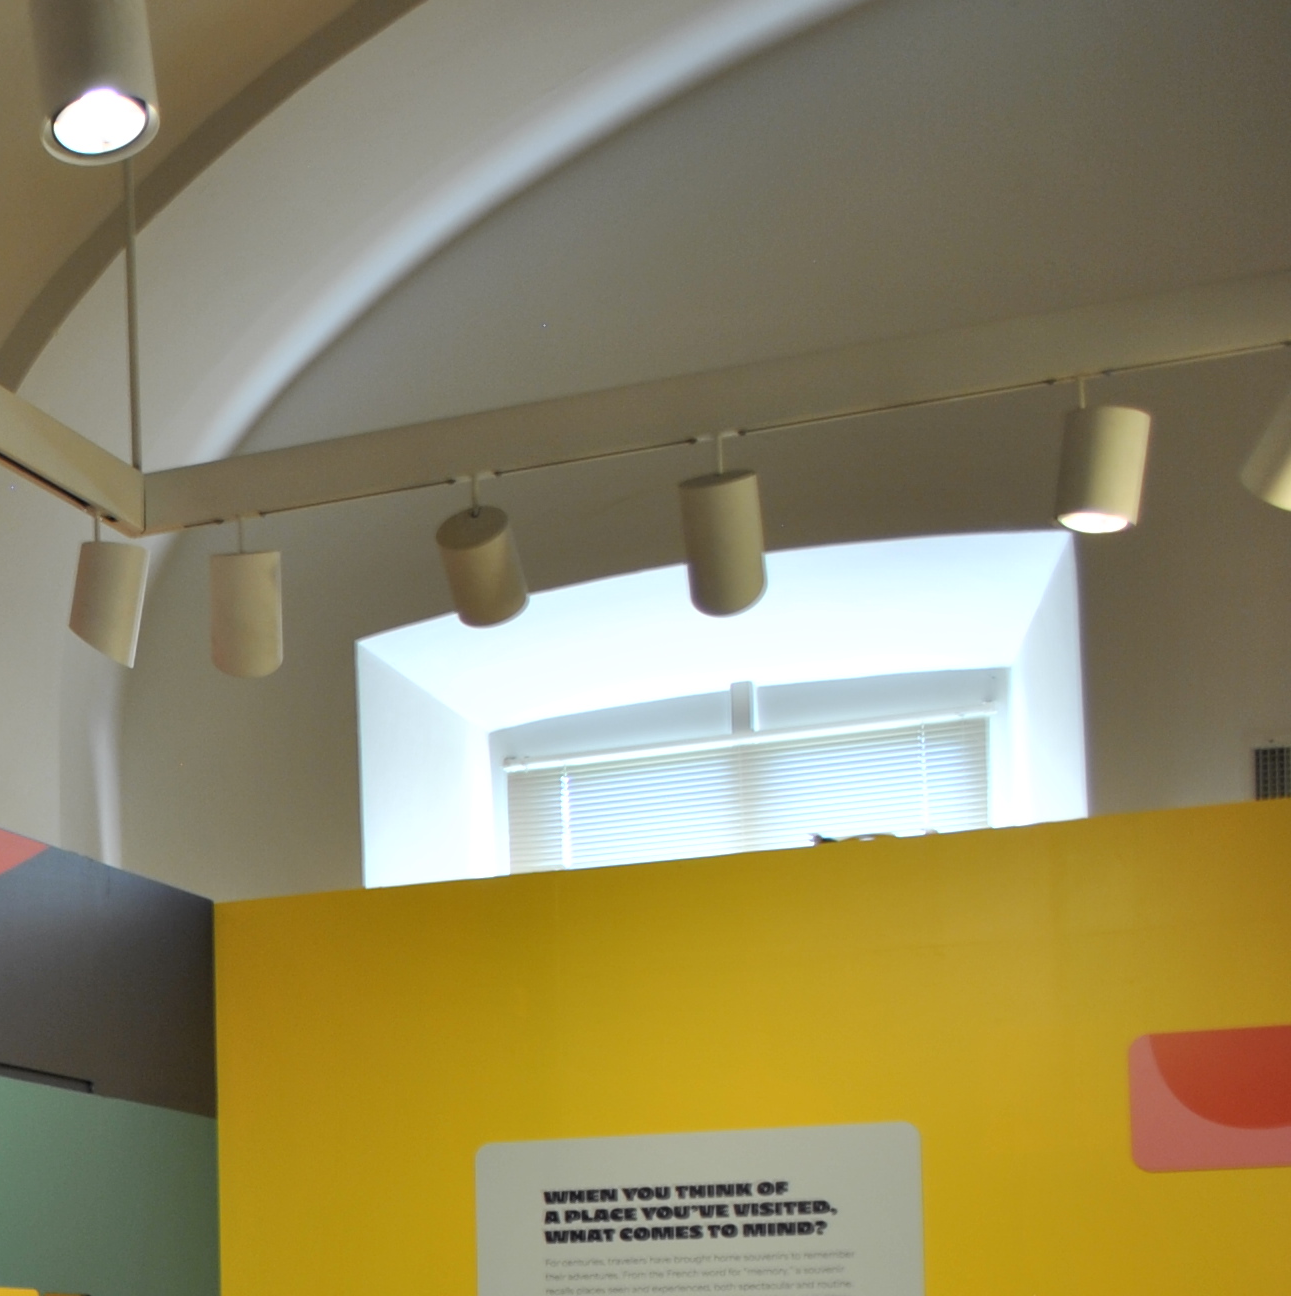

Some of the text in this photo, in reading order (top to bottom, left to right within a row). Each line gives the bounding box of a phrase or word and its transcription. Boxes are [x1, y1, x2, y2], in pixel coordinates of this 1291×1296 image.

[543, 1180, 788, 1204] WHEN YOU THINK OF
[543, 1198, 837, 1224] A PLACE YOU'VE VISITED,
[543, 1219, 827, 1244] WHAT COMES TO MIND?
